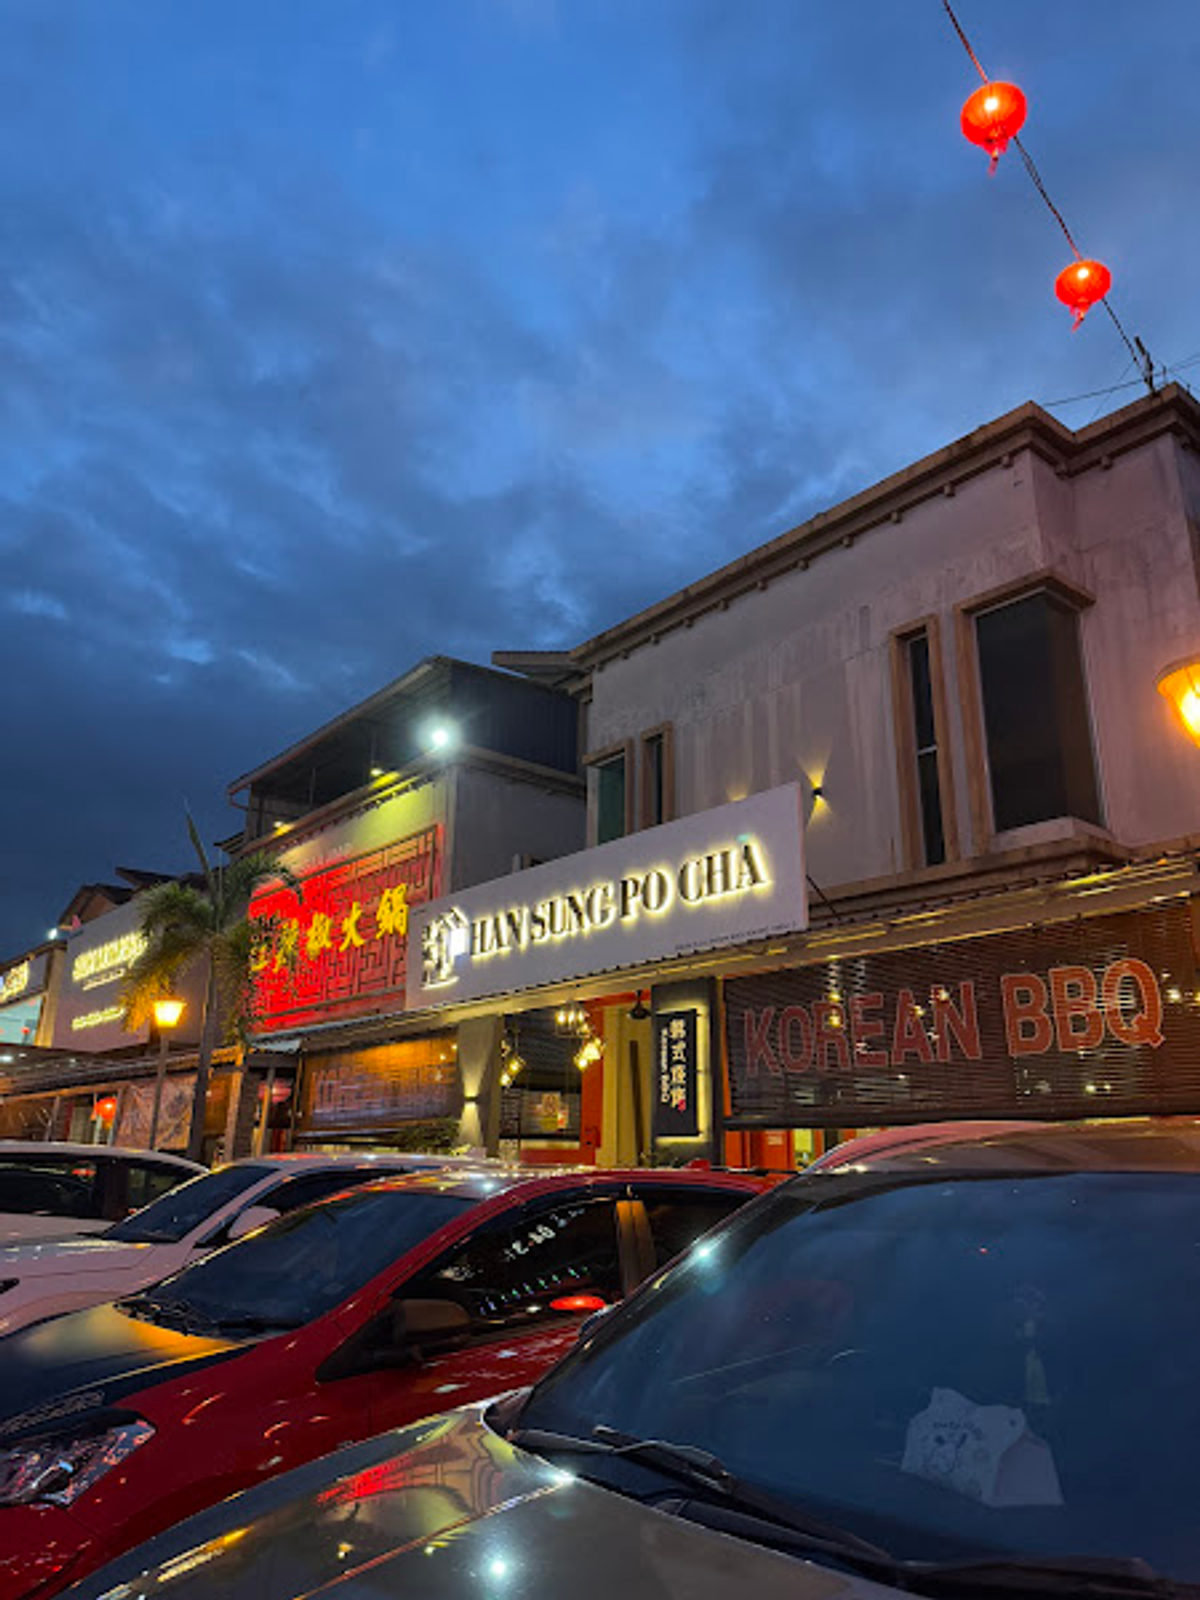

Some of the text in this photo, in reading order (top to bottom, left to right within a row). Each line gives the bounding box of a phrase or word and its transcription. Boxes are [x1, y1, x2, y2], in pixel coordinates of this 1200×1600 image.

[469, 902, 529, 956] HAN
[531, 881, 615, 943] SUNG
[618, 868, 671, 919] PO
[676, 841, 769, 904] CHA
[743, 979, 982, 1078] KOREAN
[1000, 957, 1166, 1057] BBQ
